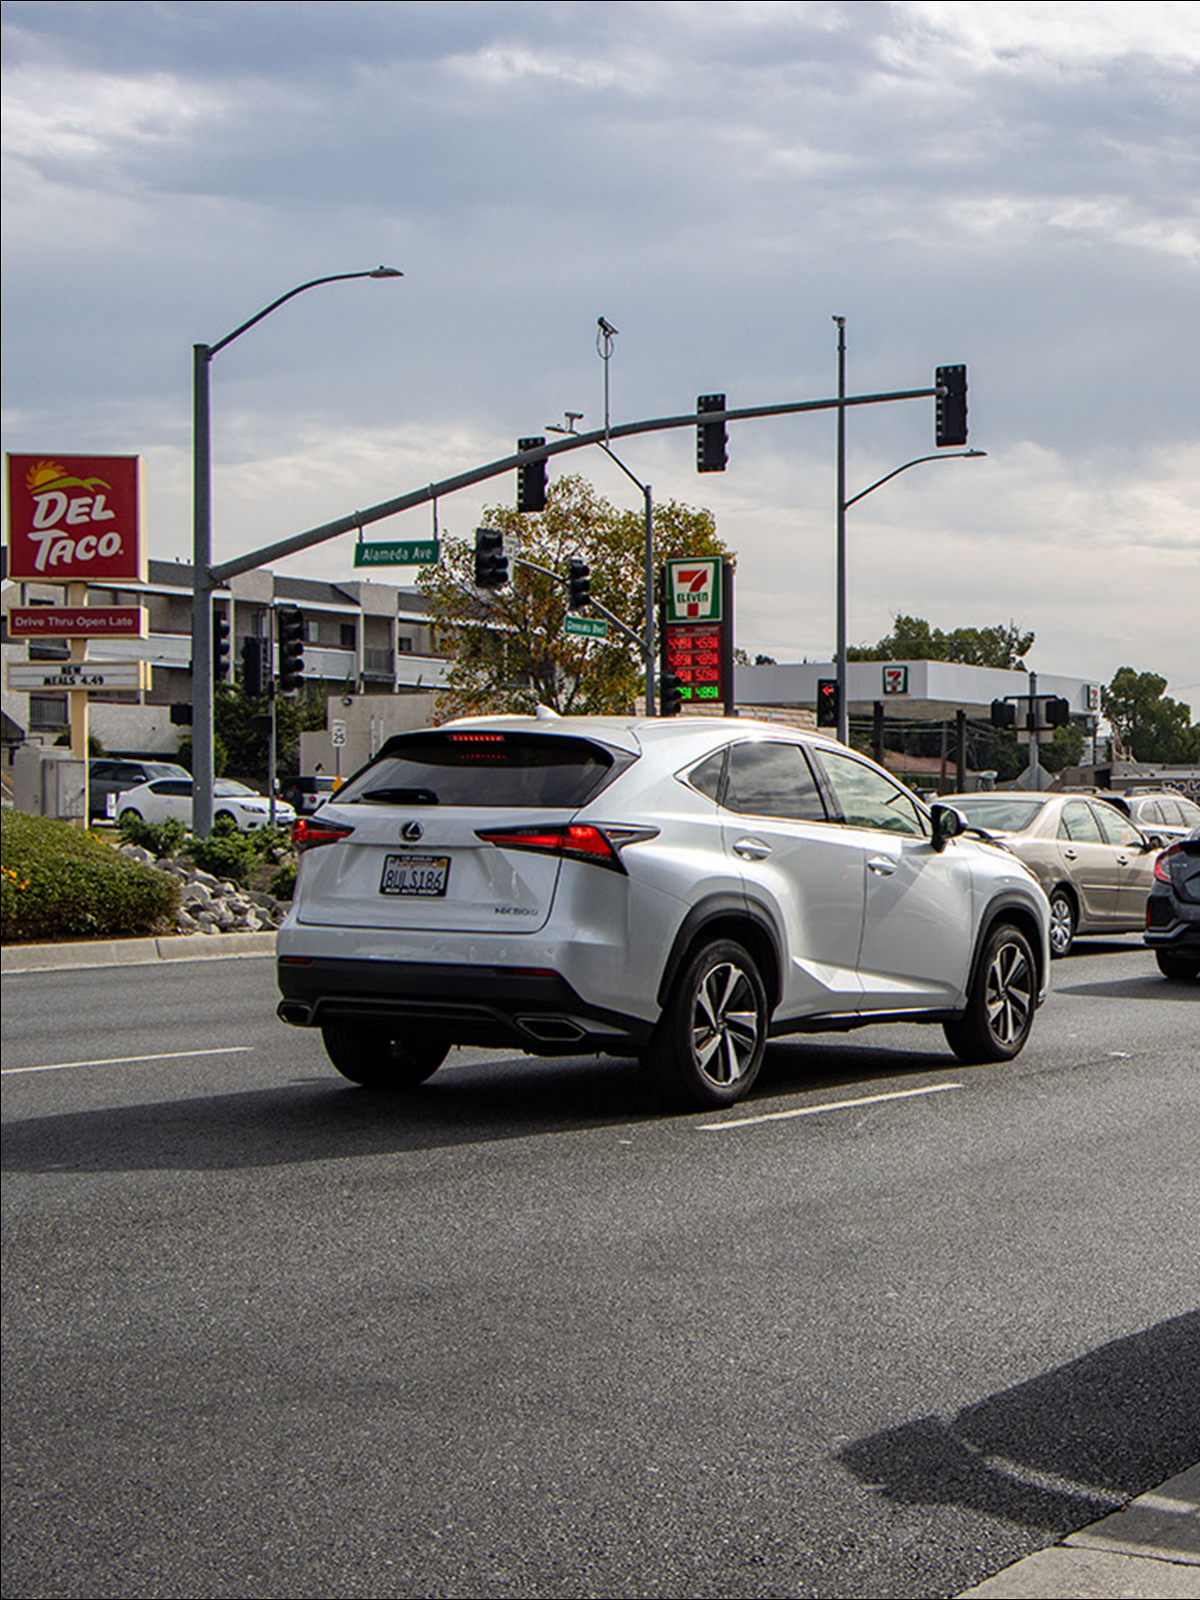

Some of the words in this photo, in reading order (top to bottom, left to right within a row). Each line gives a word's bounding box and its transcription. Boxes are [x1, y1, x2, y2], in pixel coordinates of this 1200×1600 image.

[31, 491, 116, 530] DEL
[27, 528, 122, 572] TACO
[362, 547, 408, 562] Alameda
[411, 546, 432, 560] Ave
[14, 616, 45, 627] Drive
[48, 616, 74, 627] Thru
[76, 616, 107, 629] Open
[109, 616, 133, 627] Late
[61, 666, 81, 675] NEW
[44, 676, 76, 686] MEALS
[81, 676, 104, 686] 4.49
[1164, 781, 1186, 792] The
